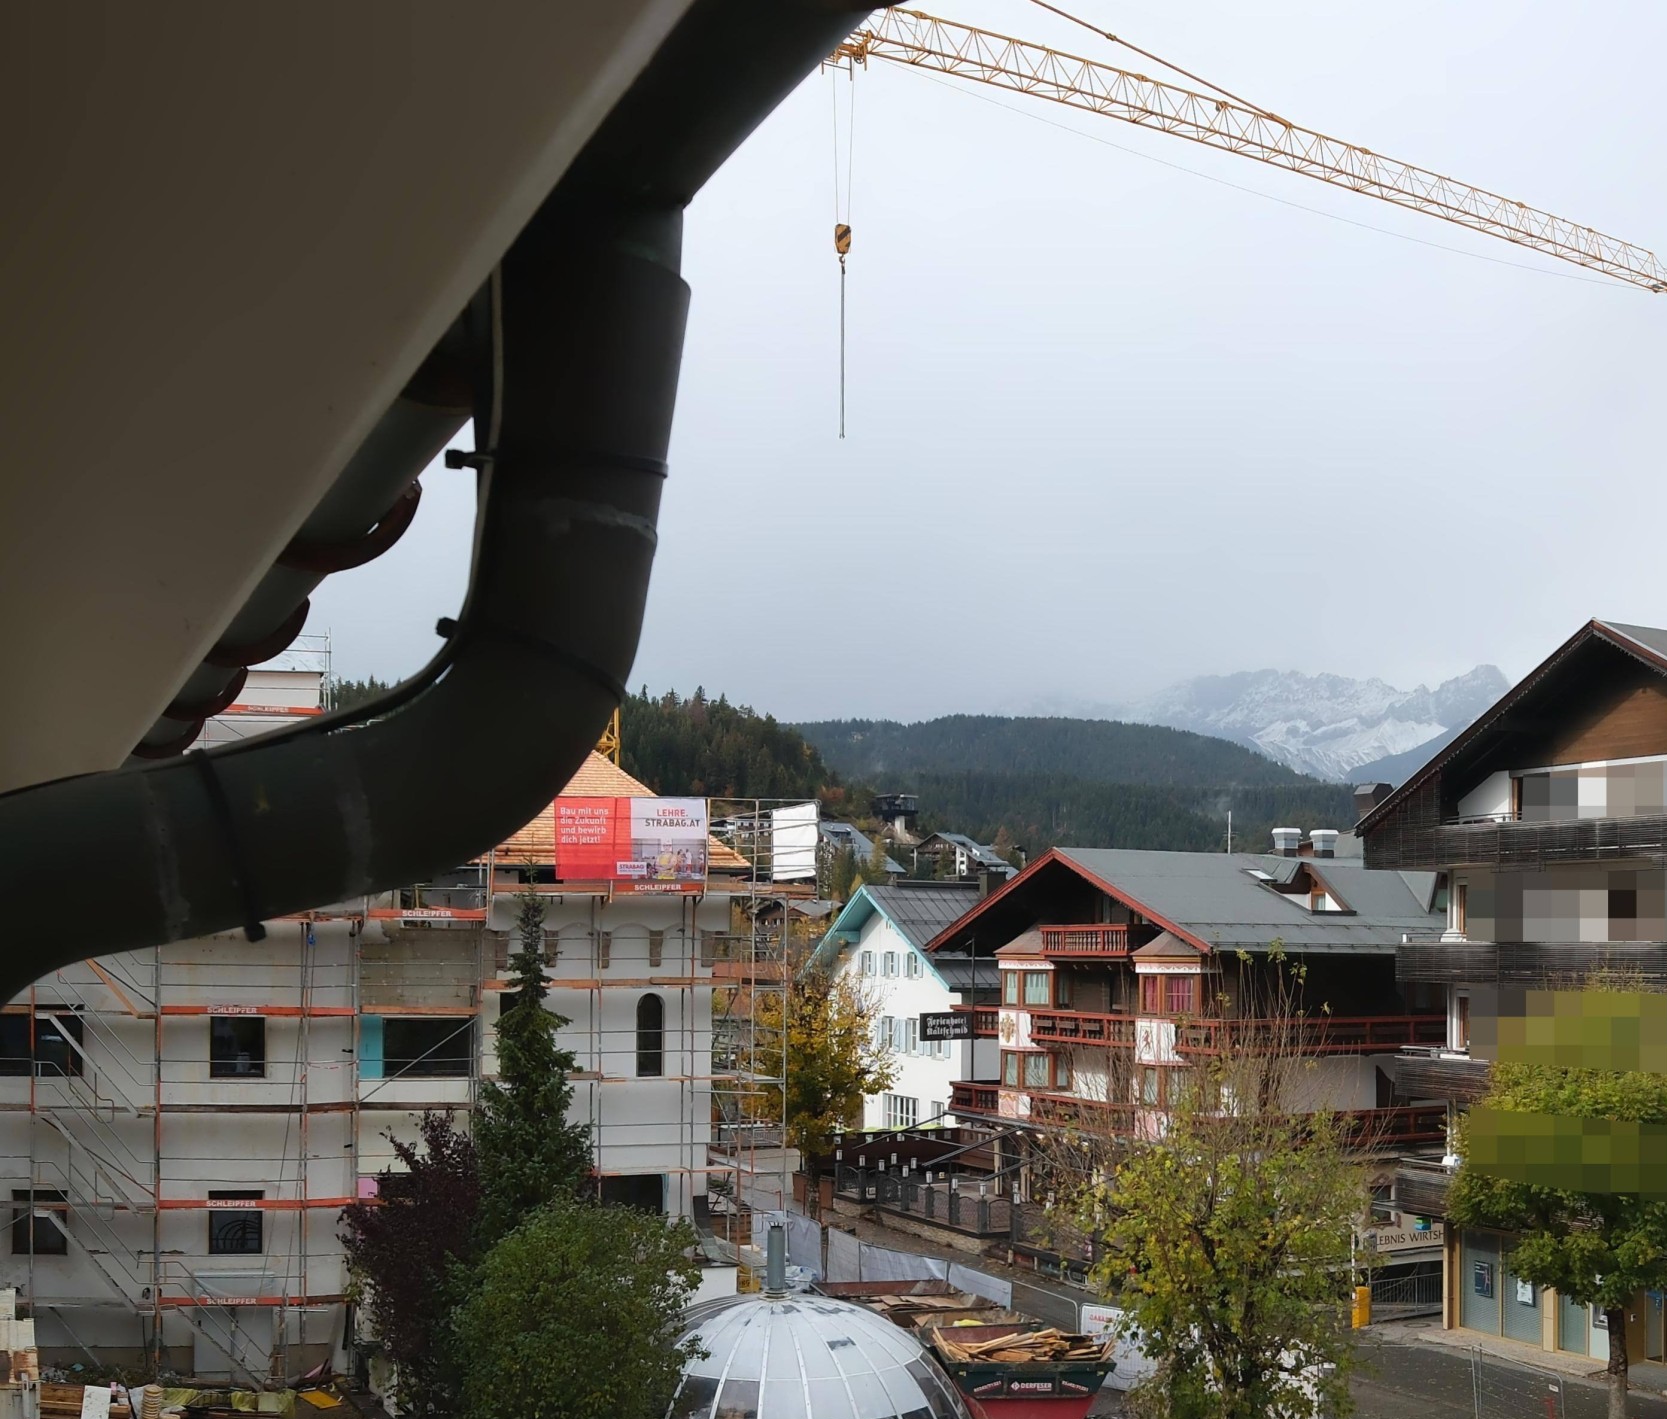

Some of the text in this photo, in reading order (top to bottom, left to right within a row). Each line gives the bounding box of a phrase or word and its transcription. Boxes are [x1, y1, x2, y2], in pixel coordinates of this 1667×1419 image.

[560, 807, 576, 815] Bau
[578, 807, 592, 815] mit
[657, 809, 689, 817] LEHRE.
[560, 817, 606, 825] die Zukunft
[645, 818, 700, 828] STRABAG.AT
[560, 826, 607, 834] und bewirb
[561, 836, 578, 844] dich
[402, 909, 452, 918] SCHLEIPFER
[207, 1006, 258, 1014] SCHLEIPFER
